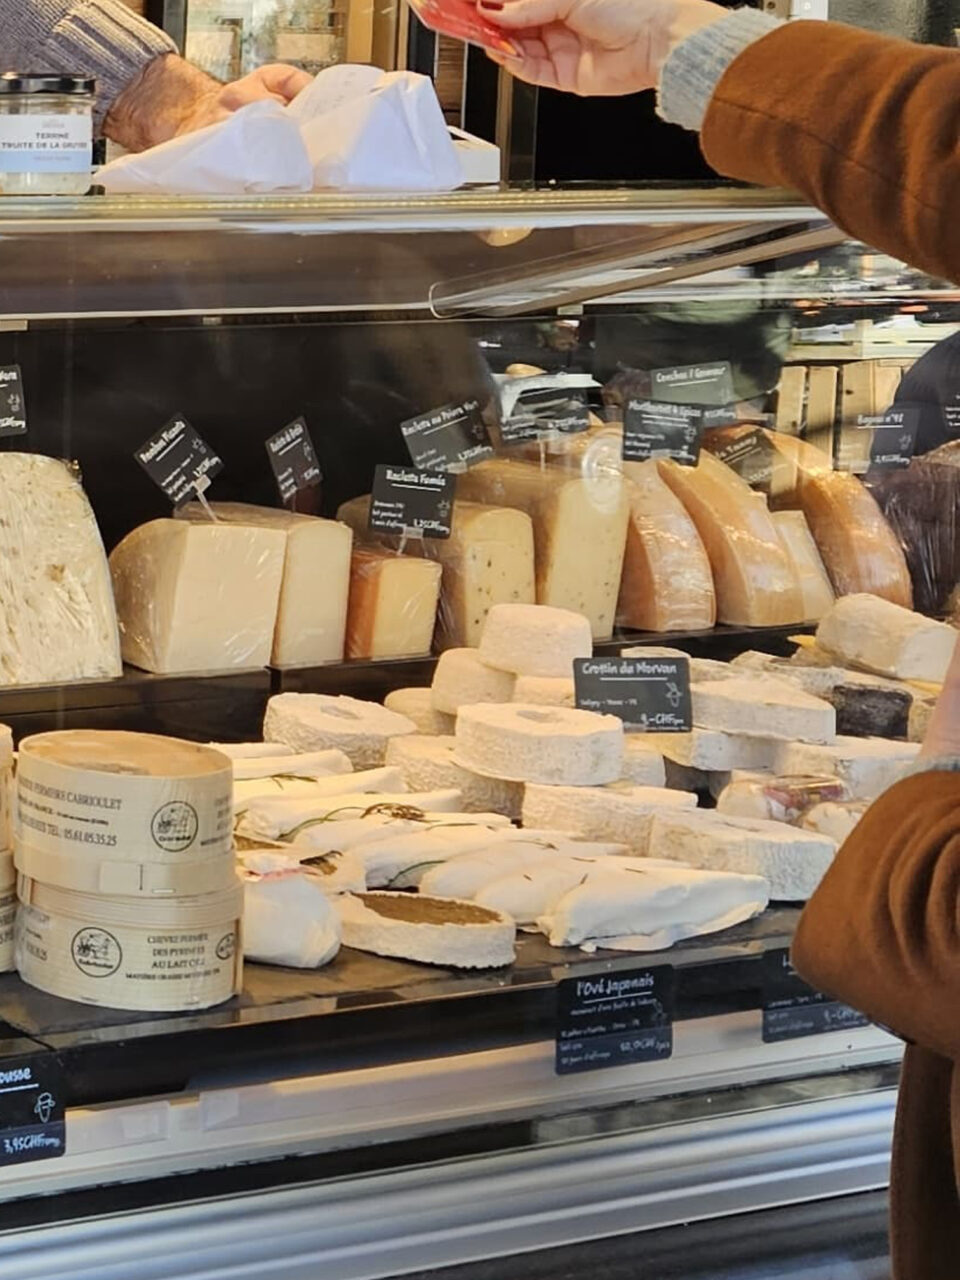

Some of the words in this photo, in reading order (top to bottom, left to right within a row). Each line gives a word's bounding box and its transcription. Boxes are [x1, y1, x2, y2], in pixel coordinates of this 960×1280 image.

[582, 662, 618, 675] Crottin
[620, 661, 635, 674] du
[636, 661, 677, 674] Morvan
[151, 960, 166, 969] AU
[167, 959, 188, 968] LAIT
